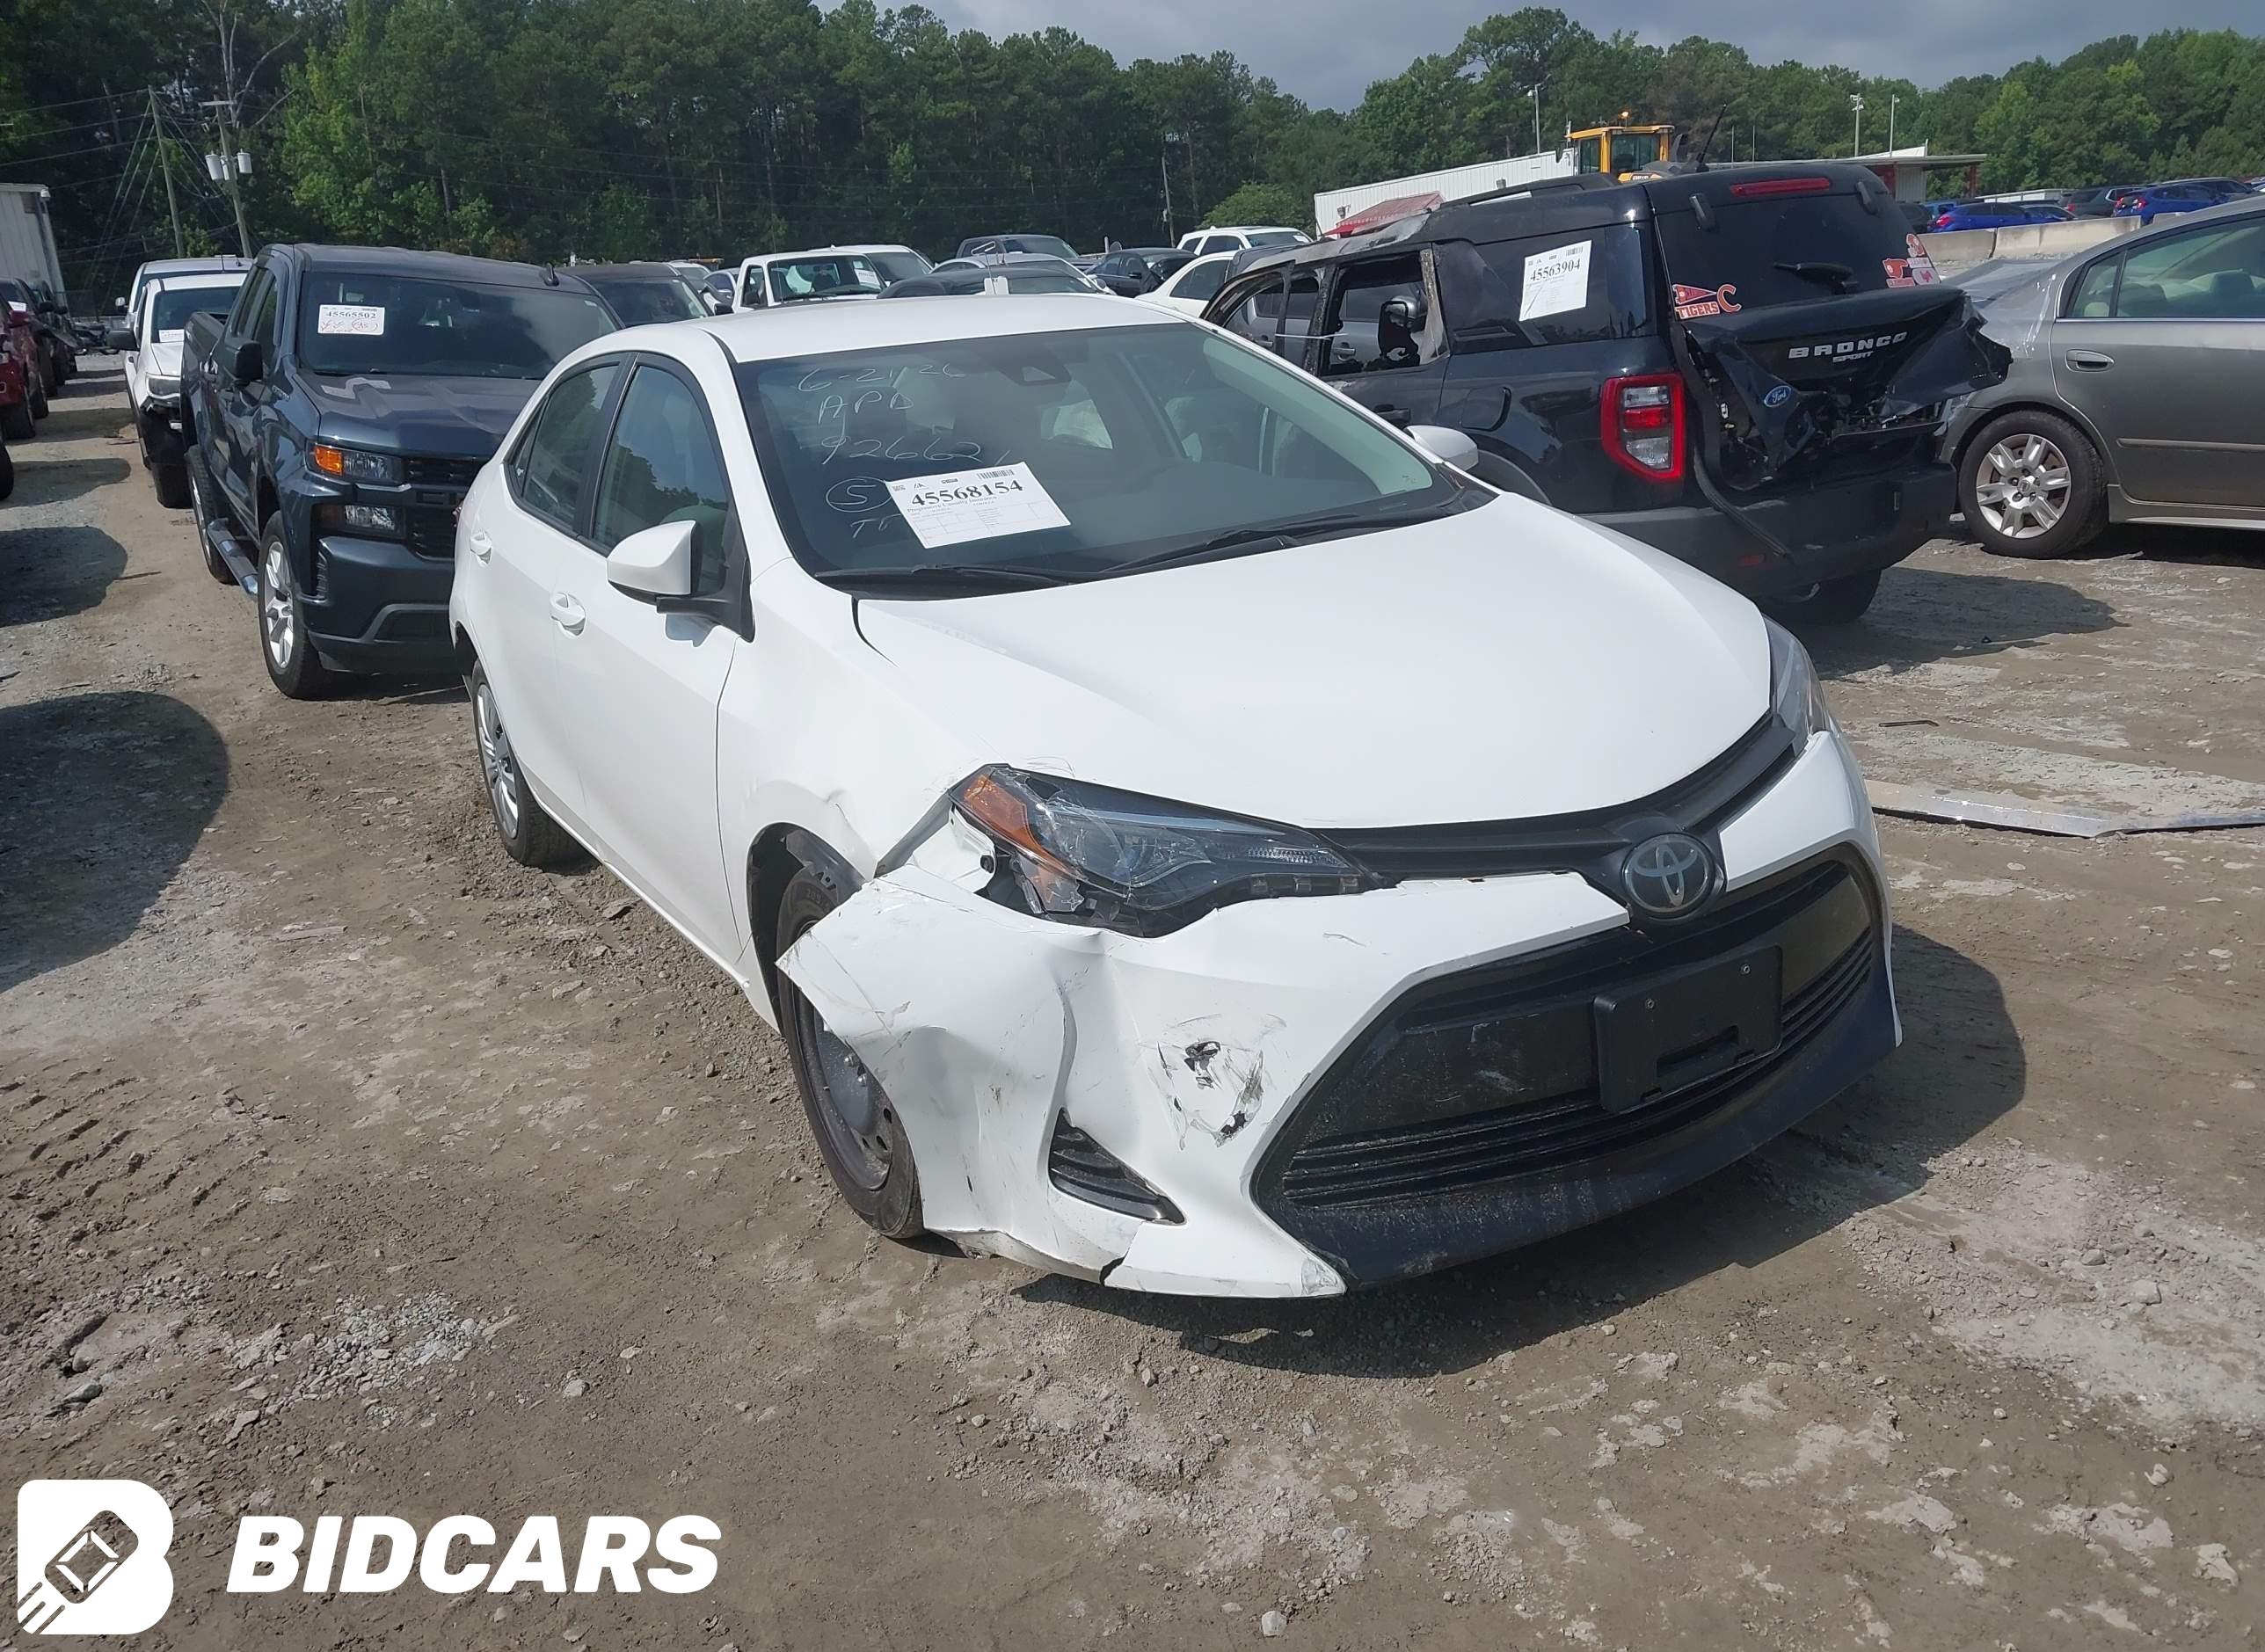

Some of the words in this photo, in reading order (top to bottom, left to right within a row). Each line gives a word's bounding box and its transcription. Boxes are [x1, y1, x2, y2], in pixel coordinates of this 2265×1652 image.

[1529, 258, 1581, 281] 45563904
[325, 310, 377, 319] 45565502
[1676, 302, 1719, 317] TIGERS
[1788, 331, 1907, 359] BRONCO
[1832, 351, 1874, 363] SPORT
[1767, 387, 1789, 405] Ford
[911, 479, 1023, 506] 45568154
